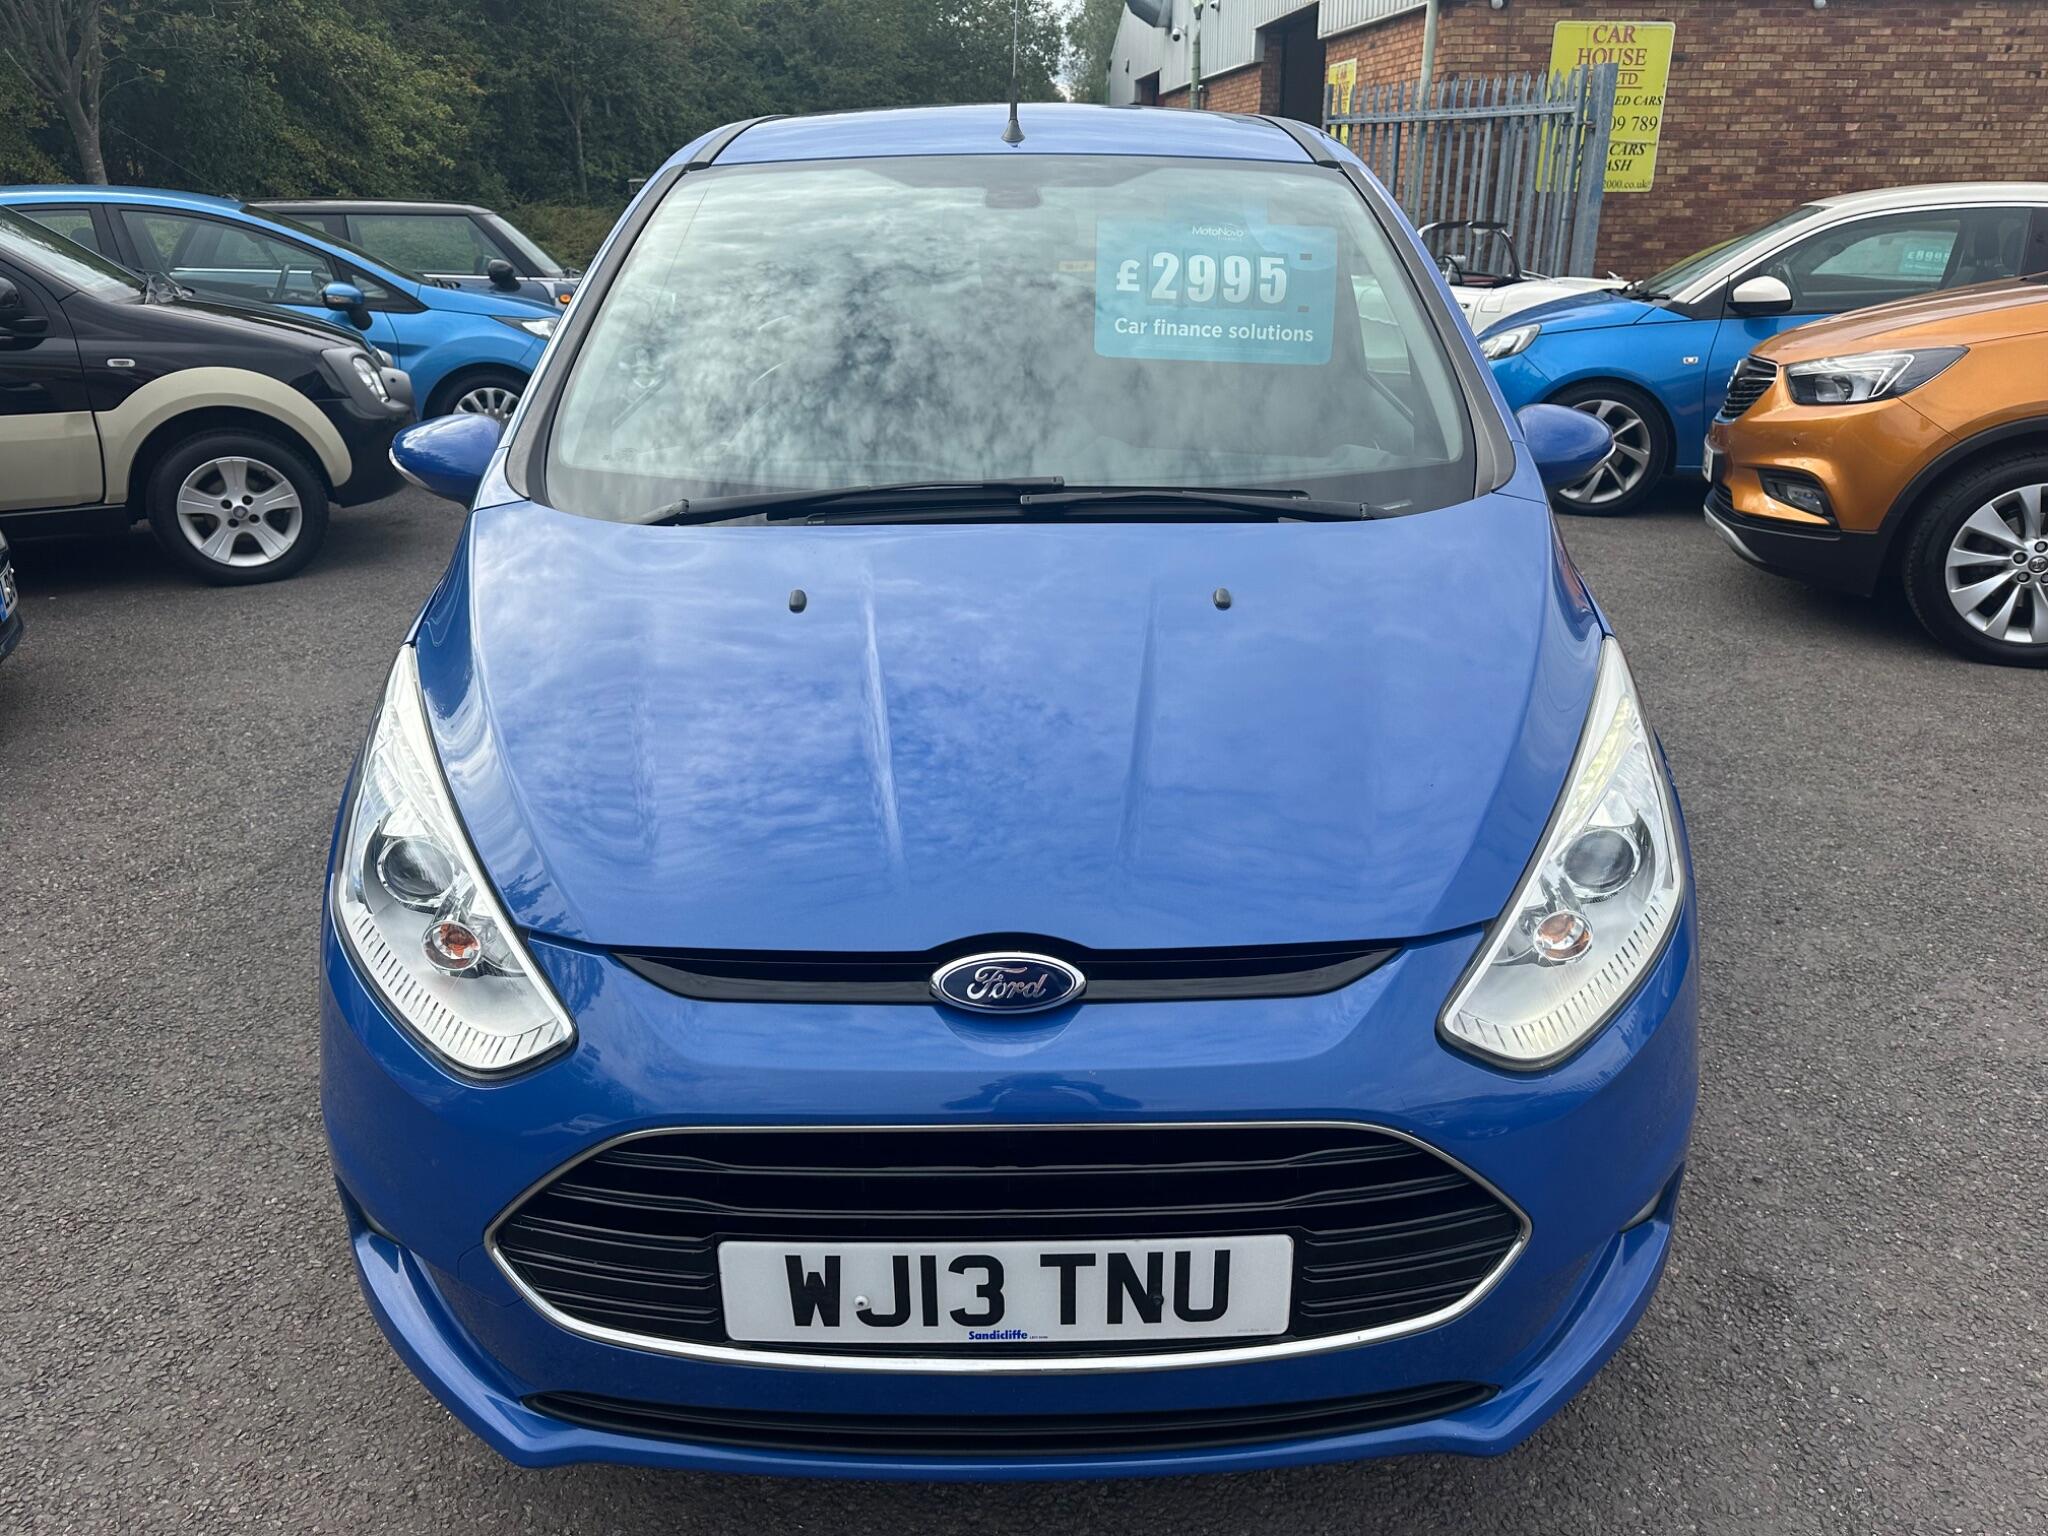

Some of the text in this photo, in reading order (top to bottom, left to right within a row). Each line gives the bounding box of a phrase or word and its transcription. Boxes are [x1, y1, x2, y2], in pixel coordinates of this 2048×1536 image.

[1592, 24, 1636, 44] CAR
[1576, 48, 1648, 66] HOUSE
[1616, 72, 1638, 85] TD
[1614, 95, 1663, 106] ED CARS
[1631, 116, 1658, 131] 789
[1609, 143, 1646, 156] CARS
[1192, 225, 1244, 237] MotoNovo
[1115, 252, 1287, 304] £2995
[1114, 317, 1314, 342] Car finance solutions
[966, 966, 1049, 1000] Ford
[784, 1249, 1231, 1327] WJ13 TNU
[968, 1329, 1028, 1340] Sandicliffe
